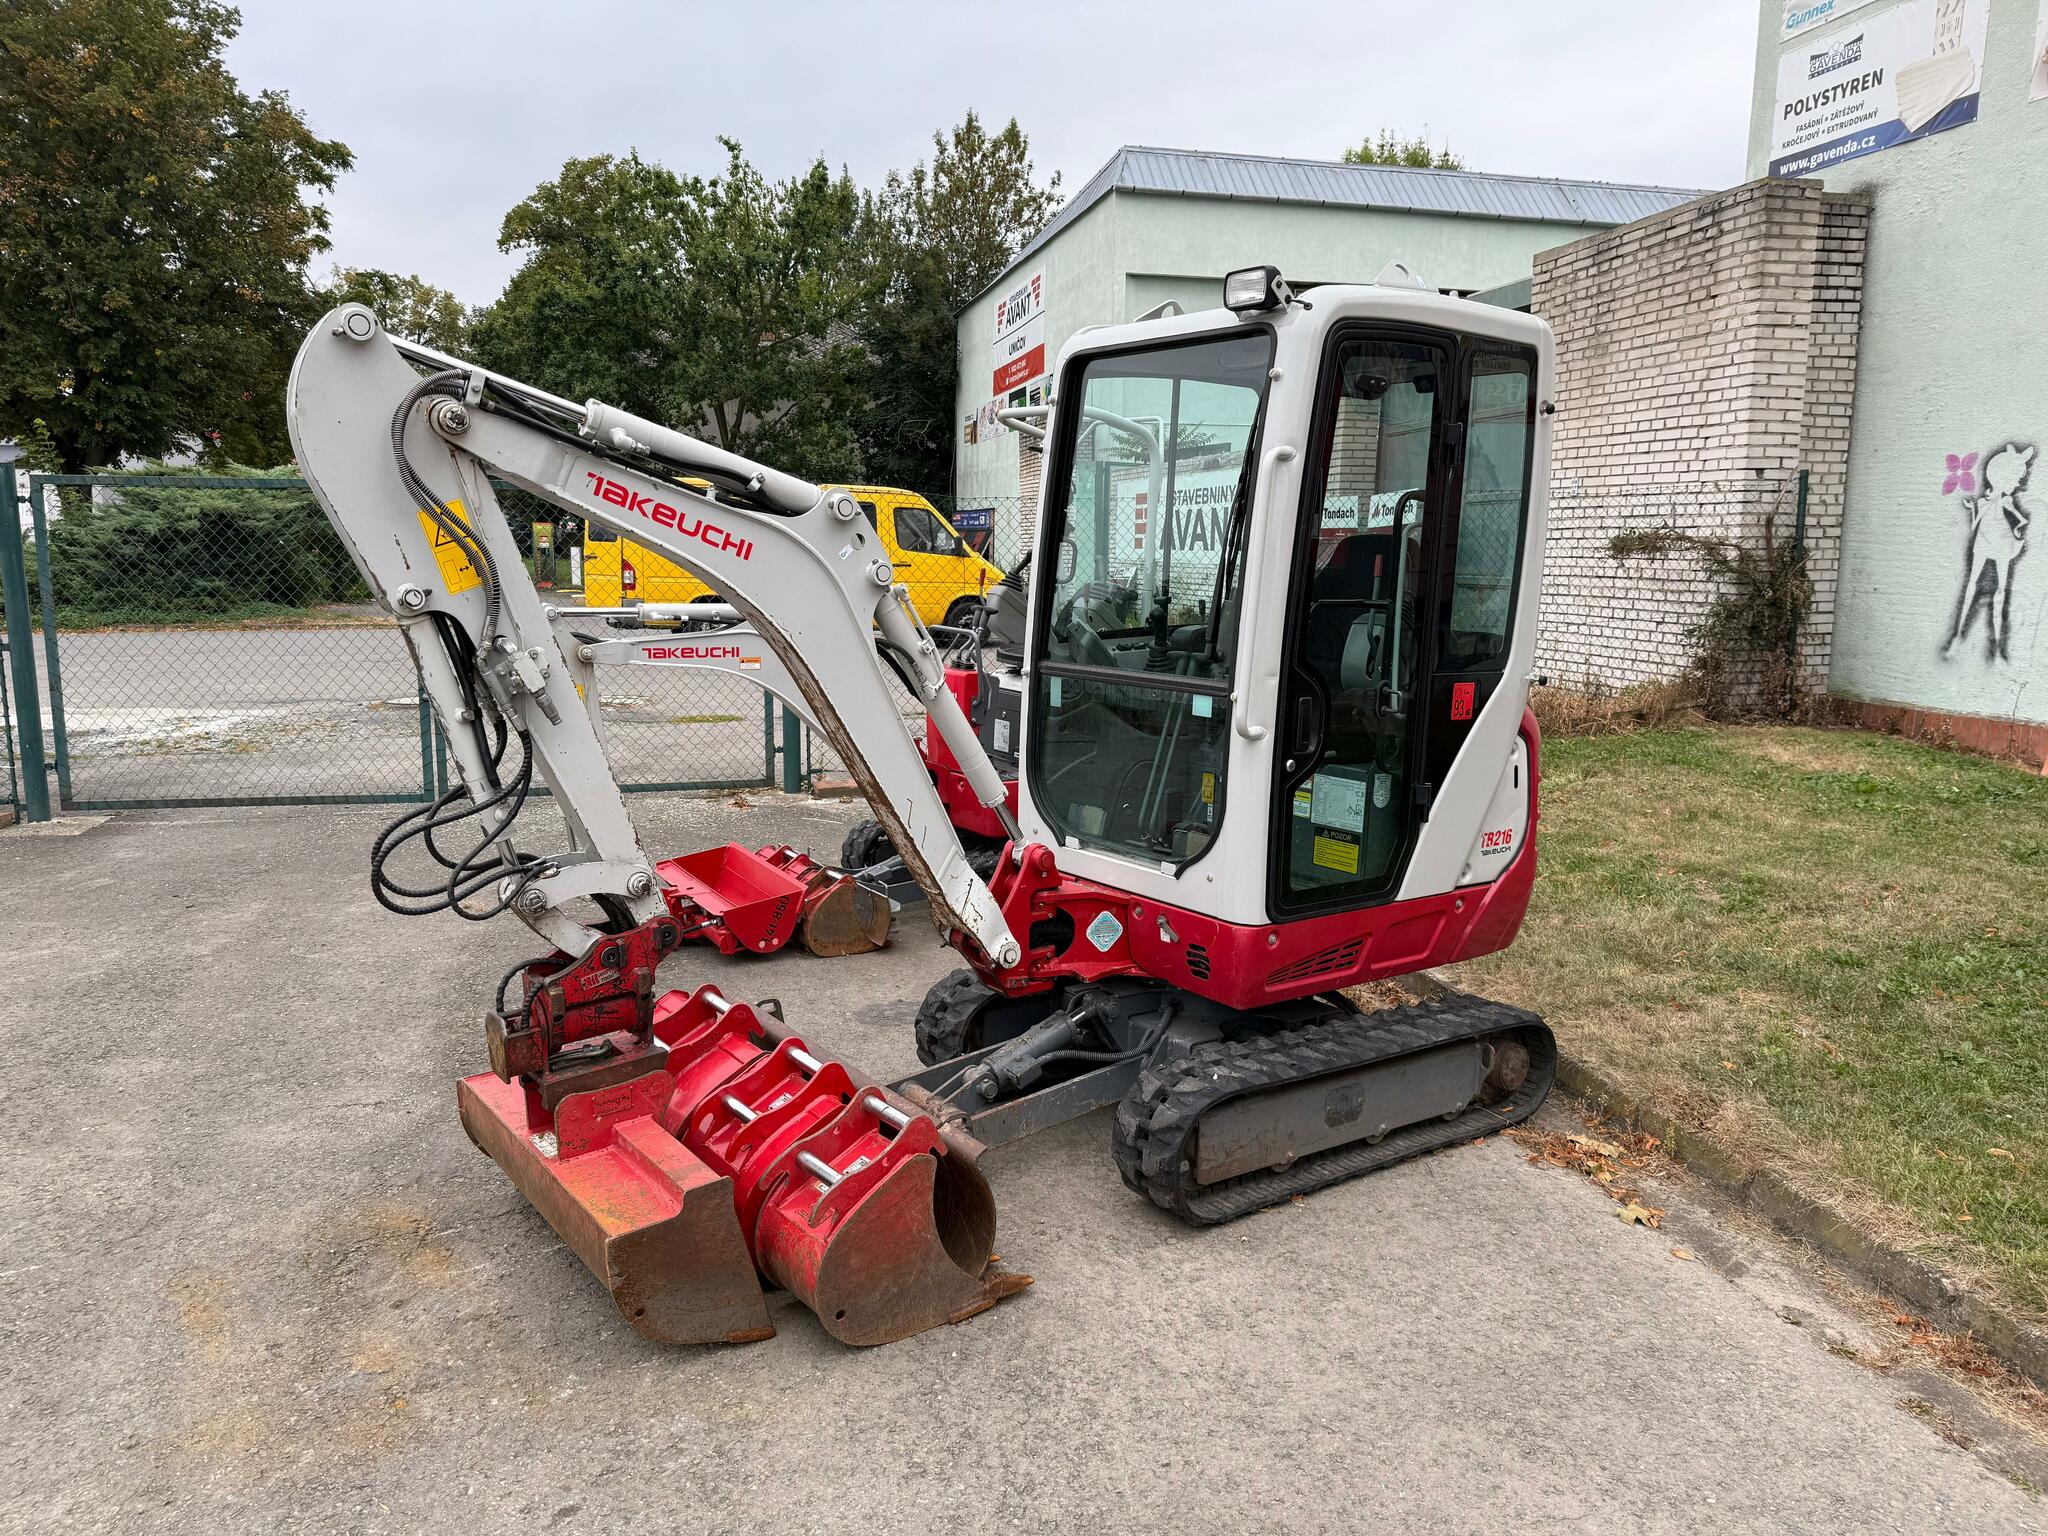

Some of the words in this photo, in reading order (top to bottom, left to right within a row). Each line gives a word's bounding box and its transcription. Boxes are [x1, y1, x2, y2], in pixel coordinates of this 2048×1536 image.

[1786, 0, 1834, 28] Gunnex
[1809, 45, 1862, 73] GAVENDA
[1783, 67, 1884, 121] POLYSTYREN
[1781, 128, 1821, 150] KROČEJOVÝ
[1826, 107, 1879, 135] EXTRUDOVANÝ
[1795, 114, 1824, 134] FASÁDNÍ
[1779, 135, 1876, 175] www.gavenda.cz
[1005, 292, 1032, 330] AVANT
[1172, 484, 1237, 506] STAVEBNINY
[587, 471, 754, 561] TAKEUCHI
[1323, 507, 1355, 519] Tondach
[1381, 500, 1414, 517] Tonch
[1158, 506, 1230, 551] AVAN
[641, 646, 740, 659] TAKEUCHI
[1453, 699, 1465, 717] 93
[1330, 831, 1352, 842] POZOR
[1480, 828, 1513, 849] TB216
